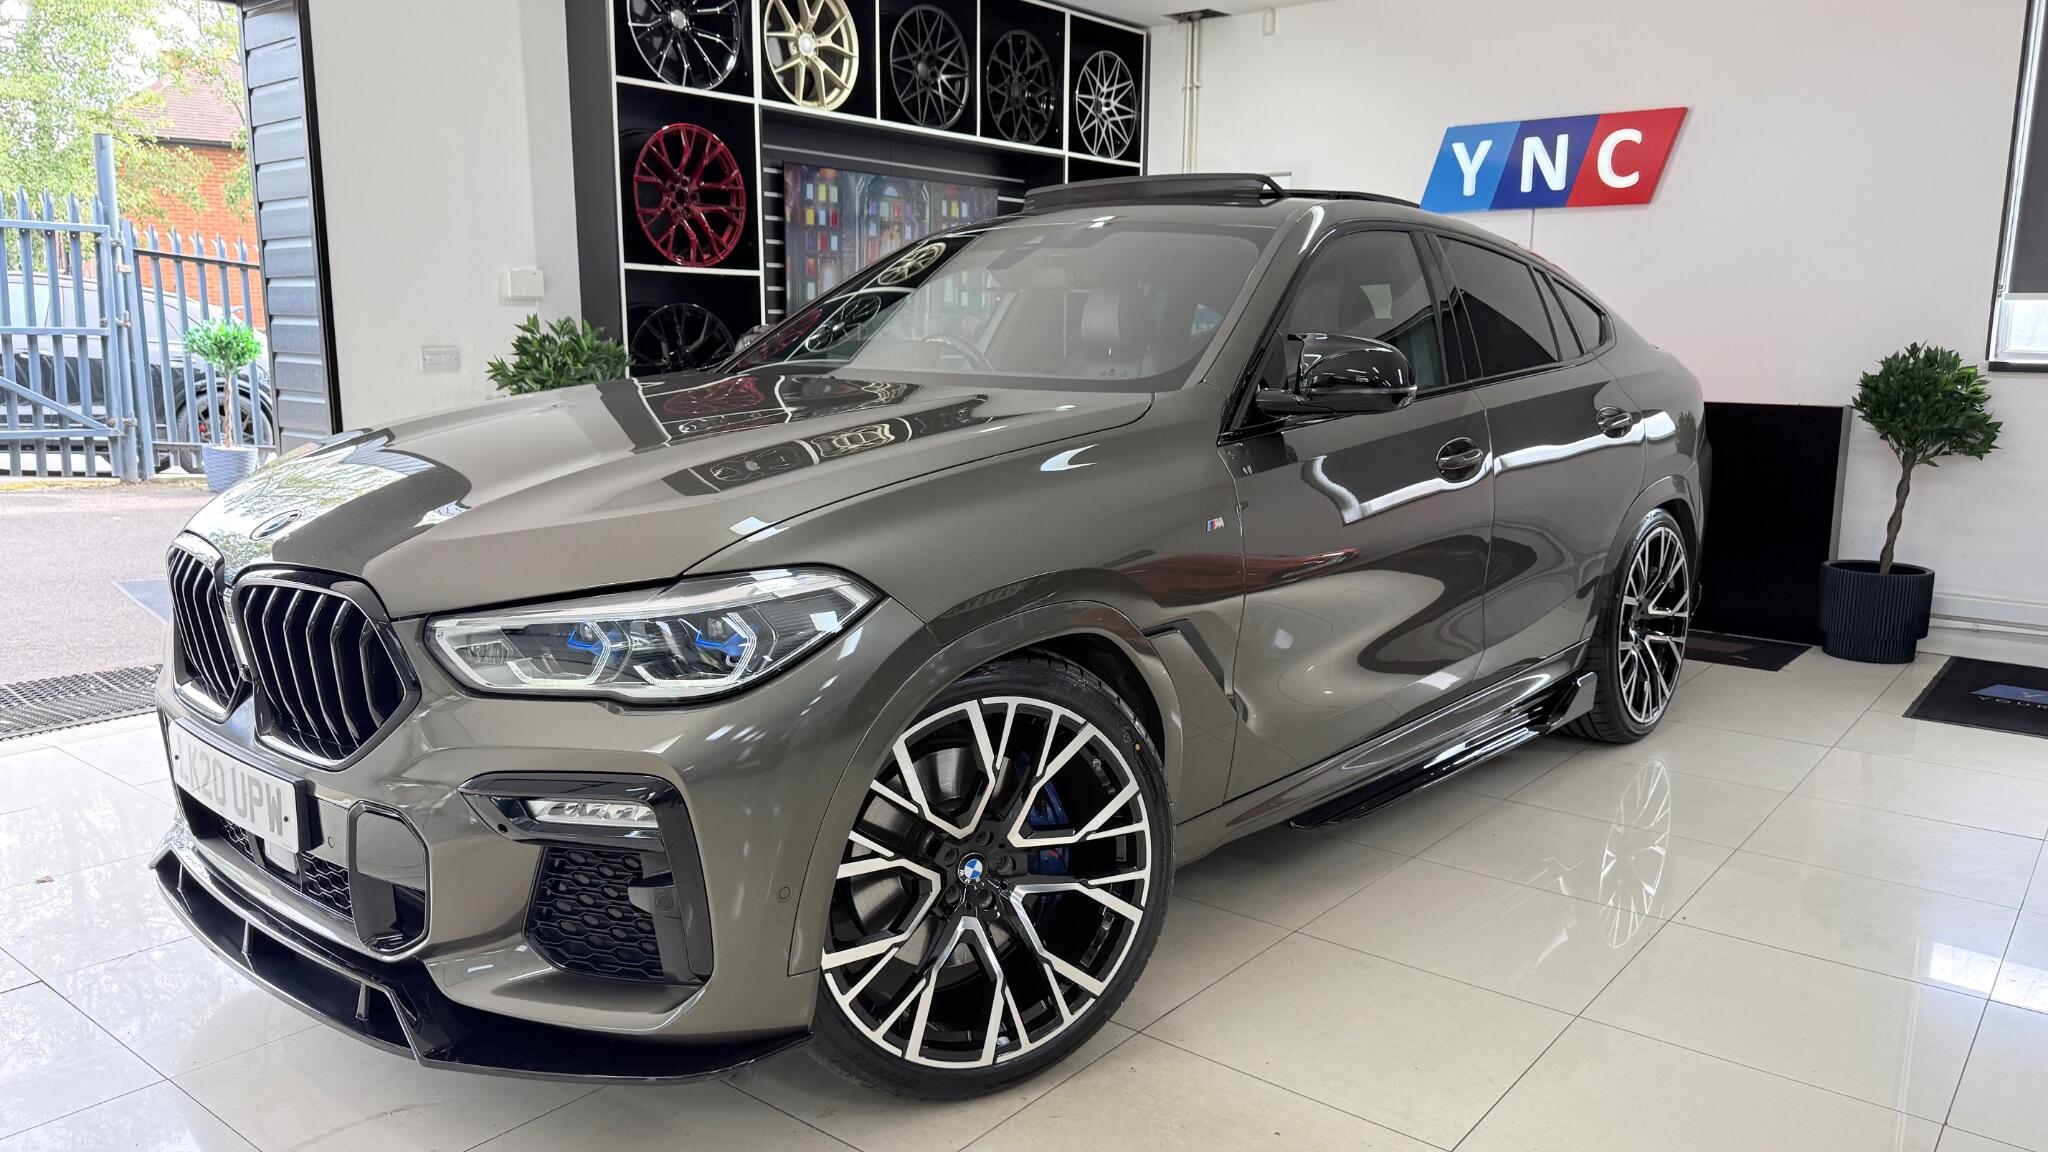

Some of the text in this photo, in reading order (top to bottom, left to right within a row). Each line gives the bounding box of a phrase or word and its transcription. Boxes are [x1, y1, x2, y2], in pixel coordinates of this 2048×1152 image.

[1451, 128, 1643, 197] YNC
[177, 734, 284, 837] LK20 UPW
